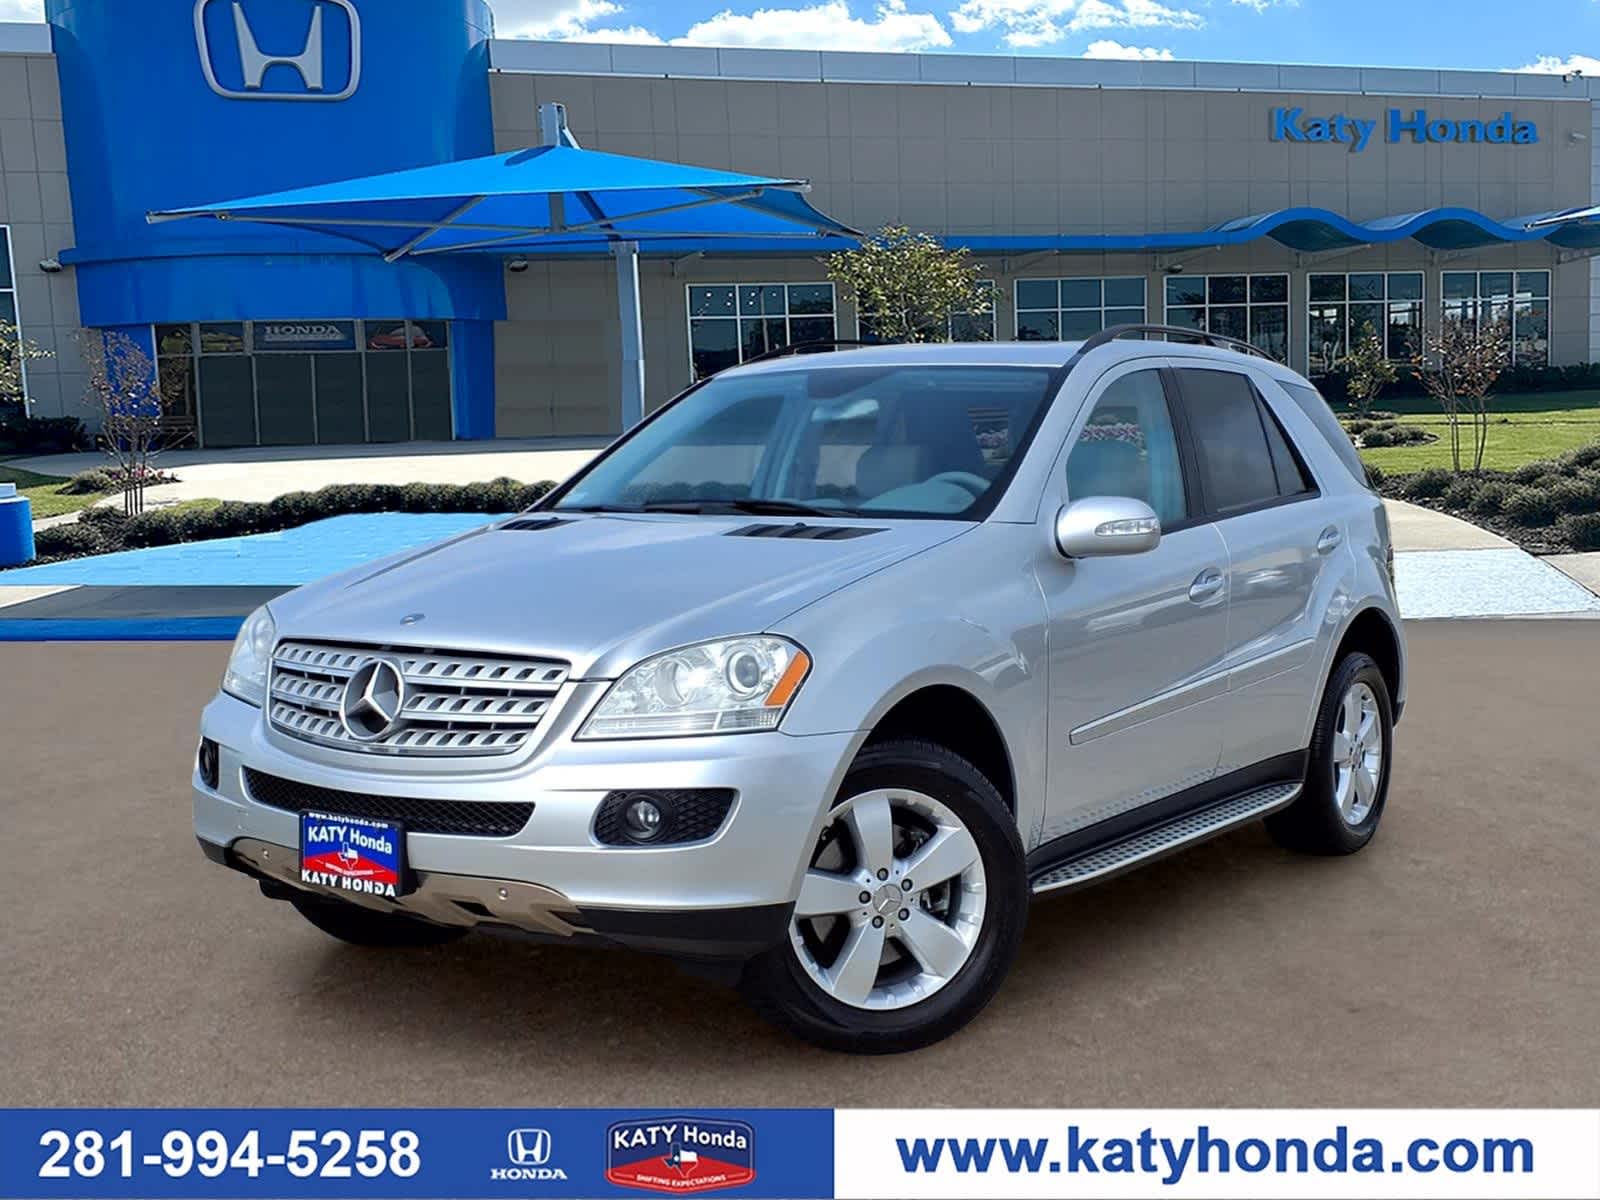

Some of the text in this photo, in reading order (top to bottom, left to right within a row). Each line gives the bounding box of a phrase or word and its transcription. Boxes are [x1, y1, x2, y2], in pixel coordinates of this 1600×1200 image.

[1270, 106, 1540, 152] Katy Honda
[264, 325, 341, 335] HONDA
[308, 825, 393, 855] KATY Honda
[302, 869, 338, 887] KATY
[342, 876, 396, 897] HONDA
